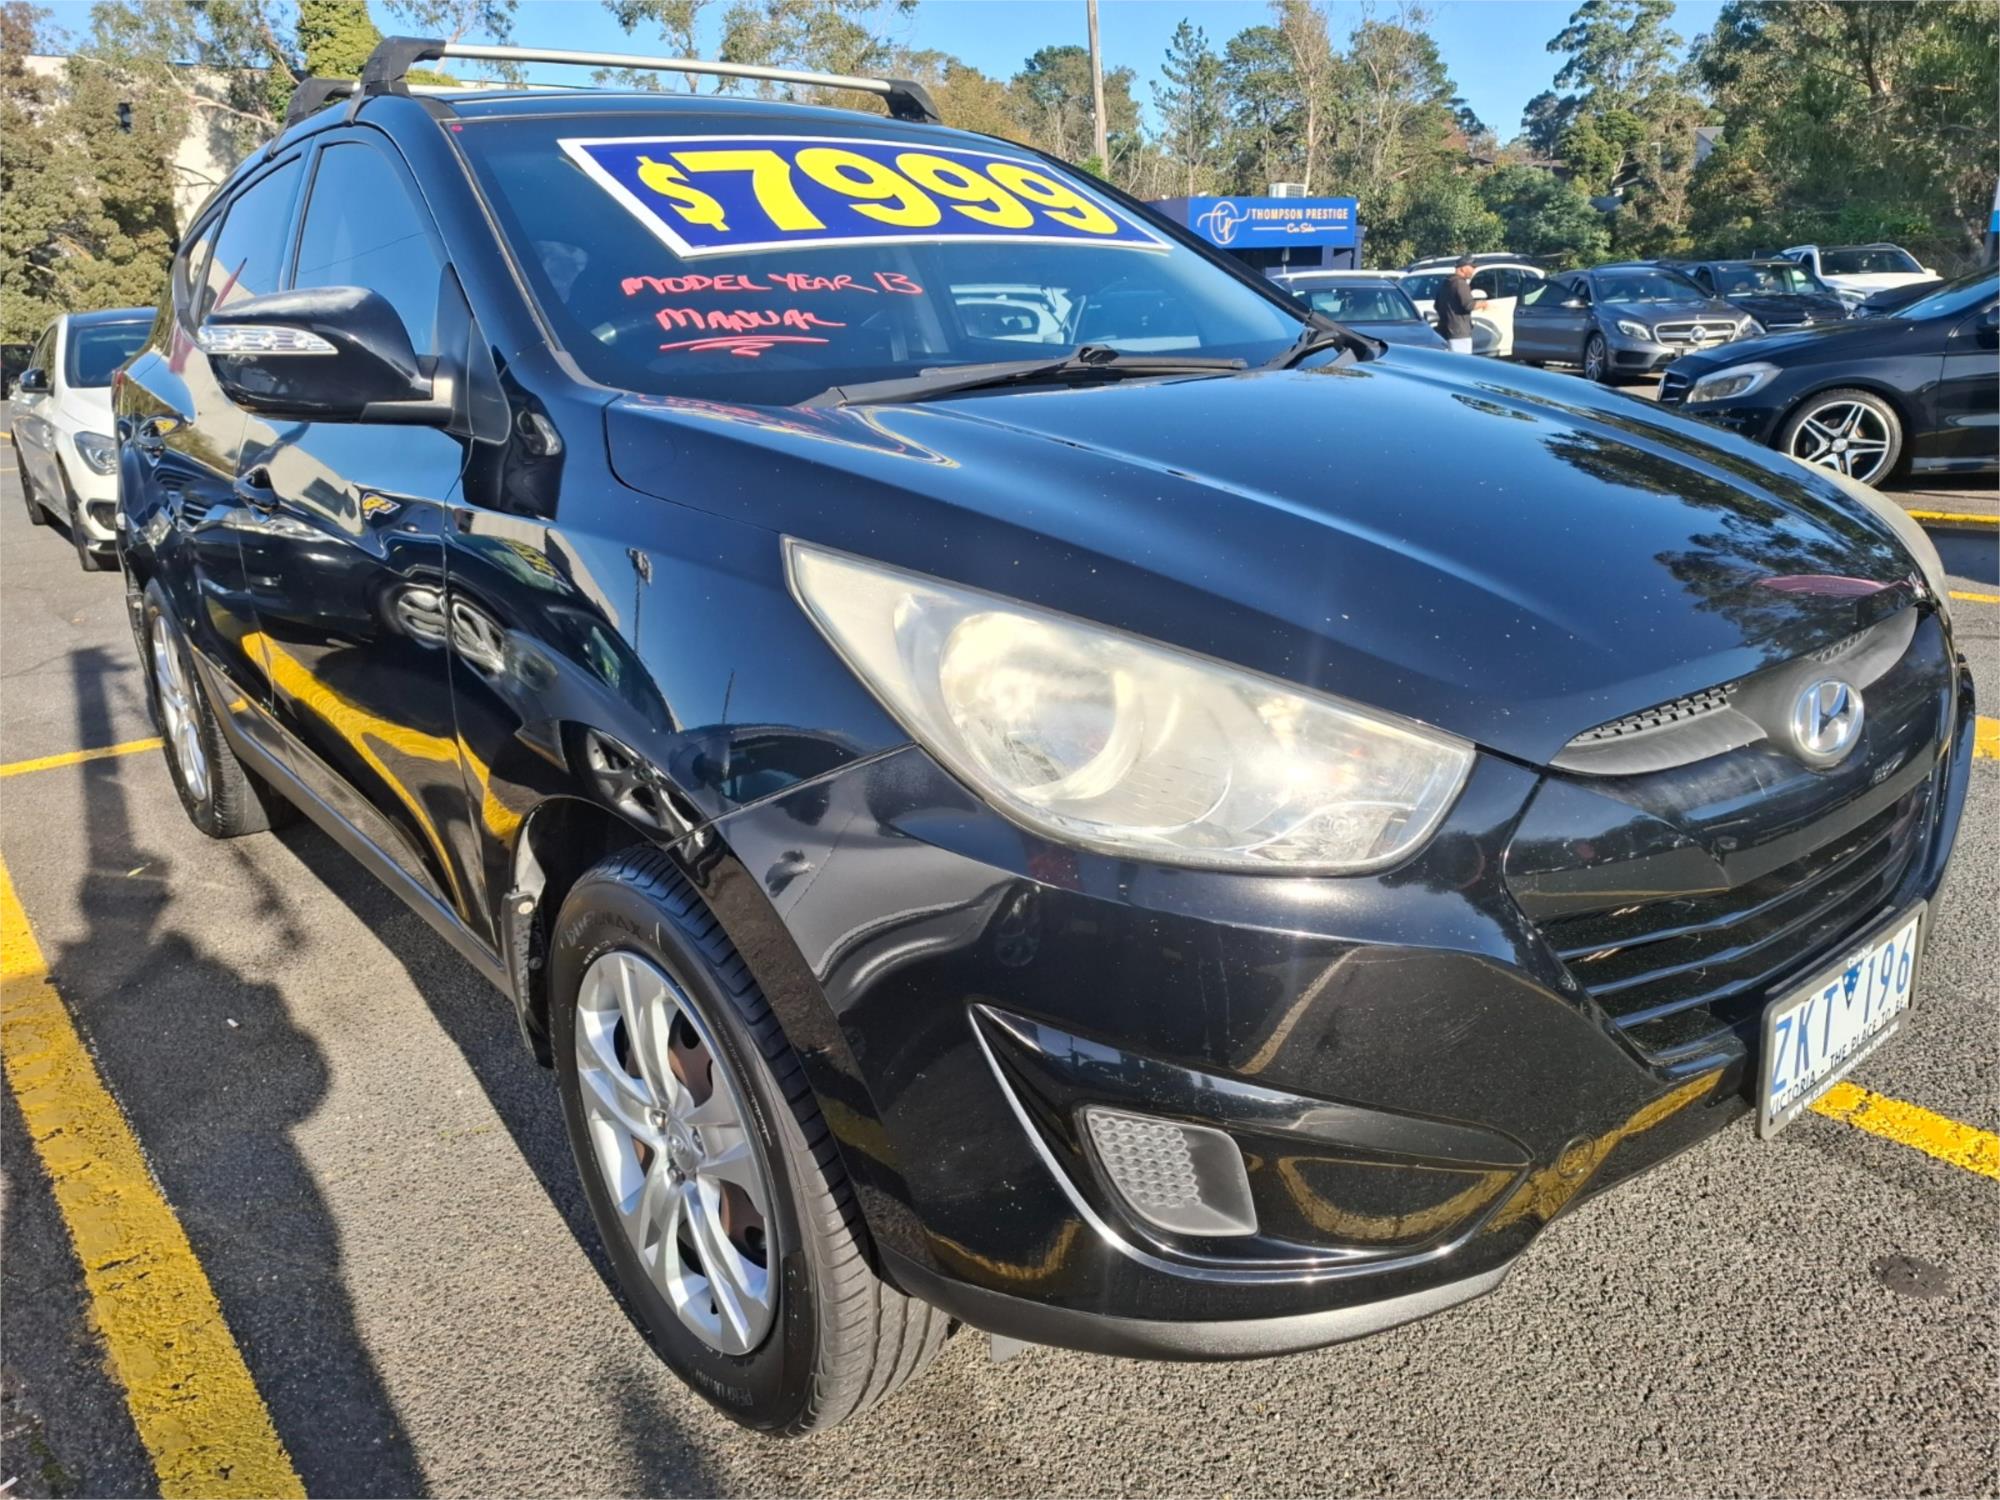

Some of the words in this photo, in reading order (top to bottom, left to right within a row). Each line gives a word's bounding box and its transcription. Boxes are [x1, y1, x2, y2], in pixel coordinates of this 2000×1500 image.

[636, 147, 1118, 234] $7999
[1251, 208, 1303, 219] THOMPSON
[1305, 208, 1348, 219] PRESTIGE
[621, 274, 773, 296] MODEL
[768, 272, 878, 293] YEAR
[874, 272, 923, 294] 13
[656, 308, 847, 332] MANUAL
[1770, 983, 1839, 1096] ZKT
[1864, 927, 1913, 1024] 196
[1770, 1070, 1817, 1115] VICTORIA
[1831, 1043, 1847, 1069] THE
[1851, 1018, 1877, 1050] PLACE
